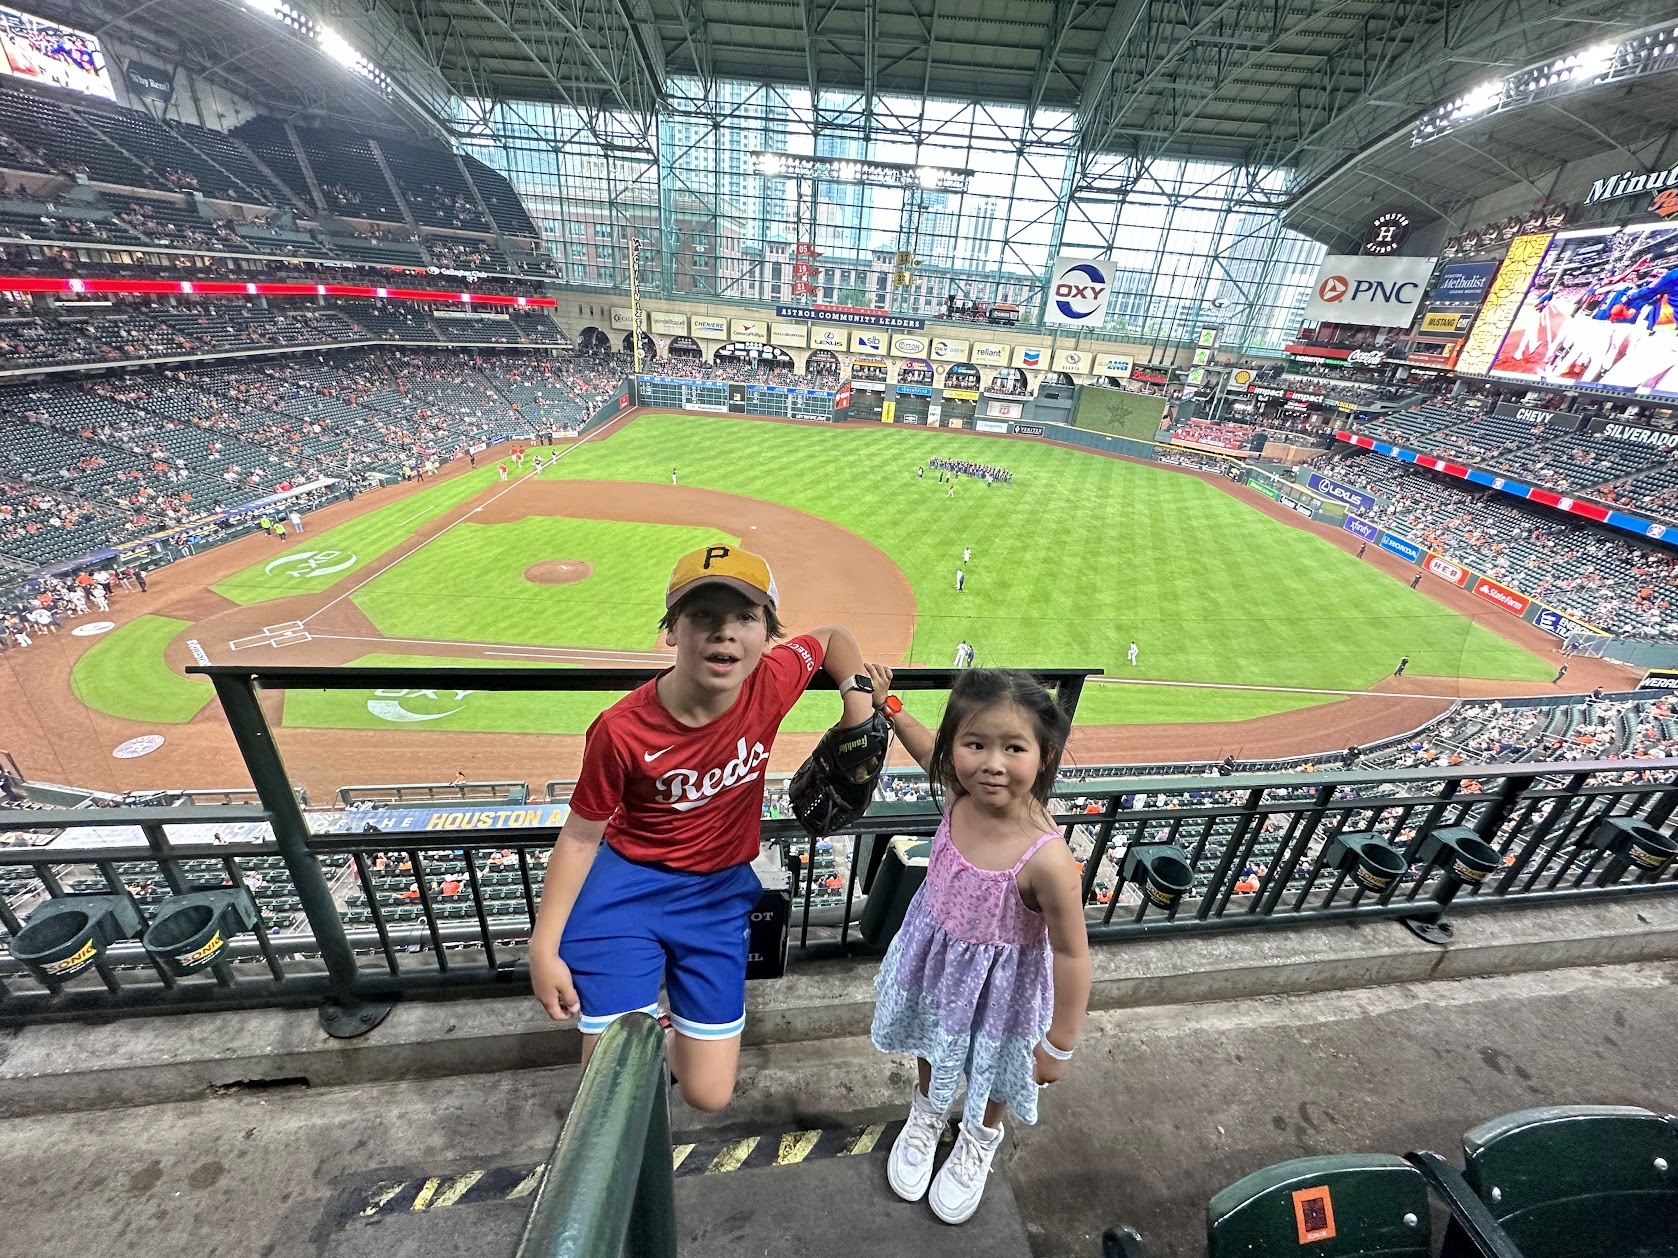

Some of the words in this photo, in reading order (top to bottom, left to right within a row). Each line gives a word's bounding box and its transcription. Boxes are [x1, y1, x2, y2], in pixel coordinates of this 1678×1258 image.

[1373, 213, 1408, 227] HOUSTON
[1376, 226, 1396, 242] H
[799, 244, 808, 253] 05
[1366, 242, 1398, 254] ASTROS
[899, 254, 909, 263] 17
[798, 264, 807, 273] 19
[796, 282, 806, 290] 21
[896, 274, 906, 282] 22
[1440, 275, 1486, 289] Methodist
[1055, 283, 1106, 300] OXY
[1350, 279, 1419, 304] PNC
[694, 320, 724, 329] CHENIERE
[781, 308, 815, 318] ASTROS
[818, 311, 877, 324] COMMUNITY
[879, 316, 920, 328] LEADERS
[1427, 318, 1456, 327] MUSTANG
[814, 339, 843, 347] LEXUS
[866, 335, 881, 345] slb
[976, 347, 1001, 358] reliant
[1254, 386, 1284, 398] impact
[1292, 392, 1324, 403] impact
[1516, 408, 1554, 424] CHEVY
[1604, 423, 1678, 448] SILVERADO
[1328, 485, 1363, 506] LEXUS
[1349, 520, 1373, 537] xfinity
[1388, 540, 1417, 558] HONDA
[703, 546, 730, 570] P
[654, 736, 770, 804] Reds
[426, 809, 544, 831] HOUSTON
[1358, 868, 1390, 886] SONIC
[1455, 863, 1486, 879] SONIC
[1147, 883, 1172, 901] SONIC
[748, 911, 774, 922] OT
[48, 942, 94, 974] SONIC
[183, 936, 221, 965] SONIC
